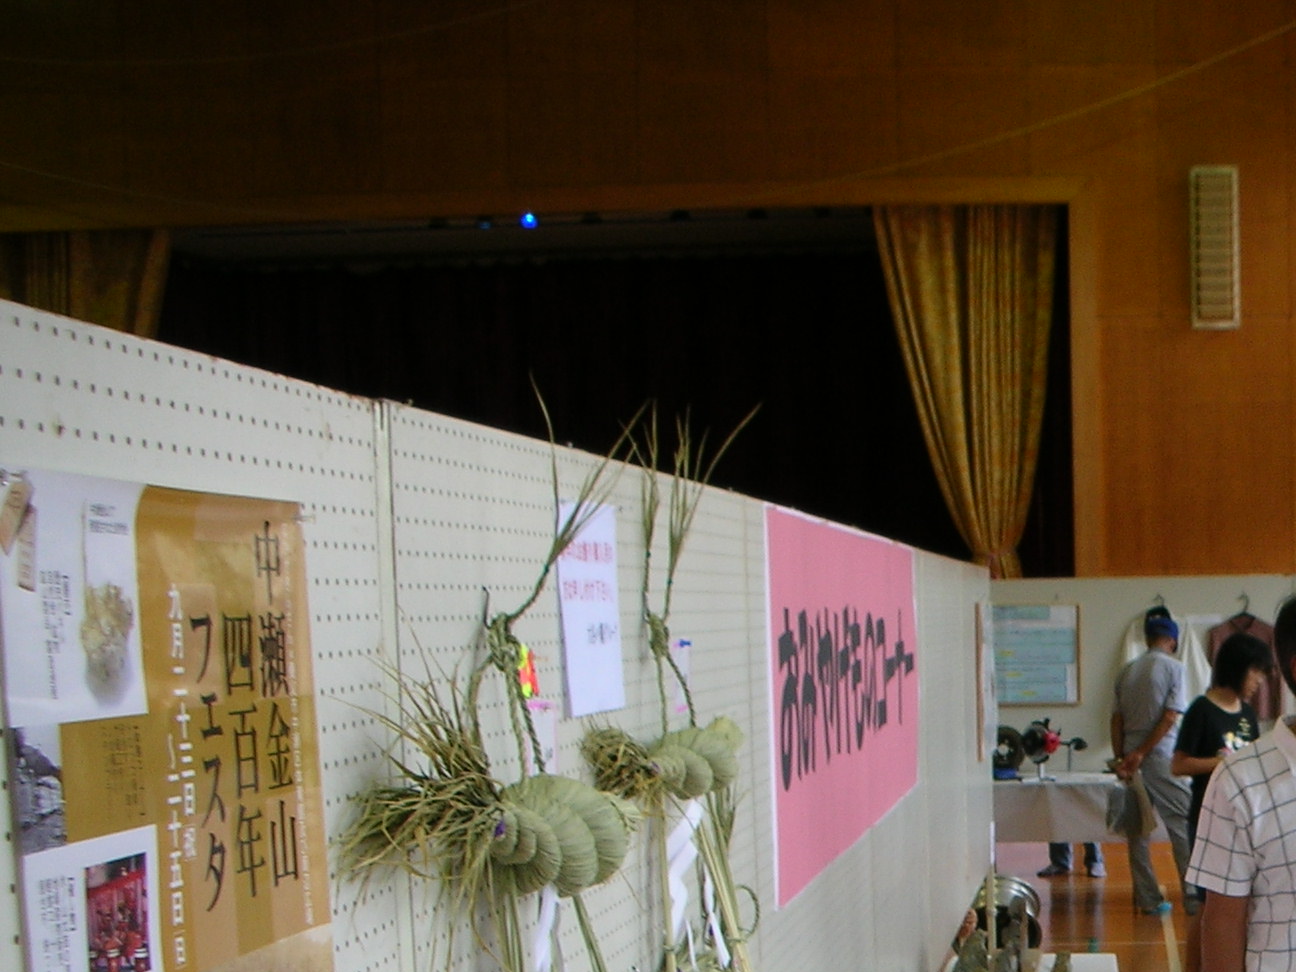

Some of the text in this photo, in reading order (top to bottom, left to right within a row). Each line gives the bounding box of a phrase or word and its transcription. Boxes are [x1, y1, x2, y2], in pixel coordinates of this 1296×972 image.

[188, 613, 226, 912] フェスタ
[222, 611, 266, 898] 四百年
[255, 520, 298, 888] 中瀬金山
[778, 604, 915, 792] おみやげものコーナー
